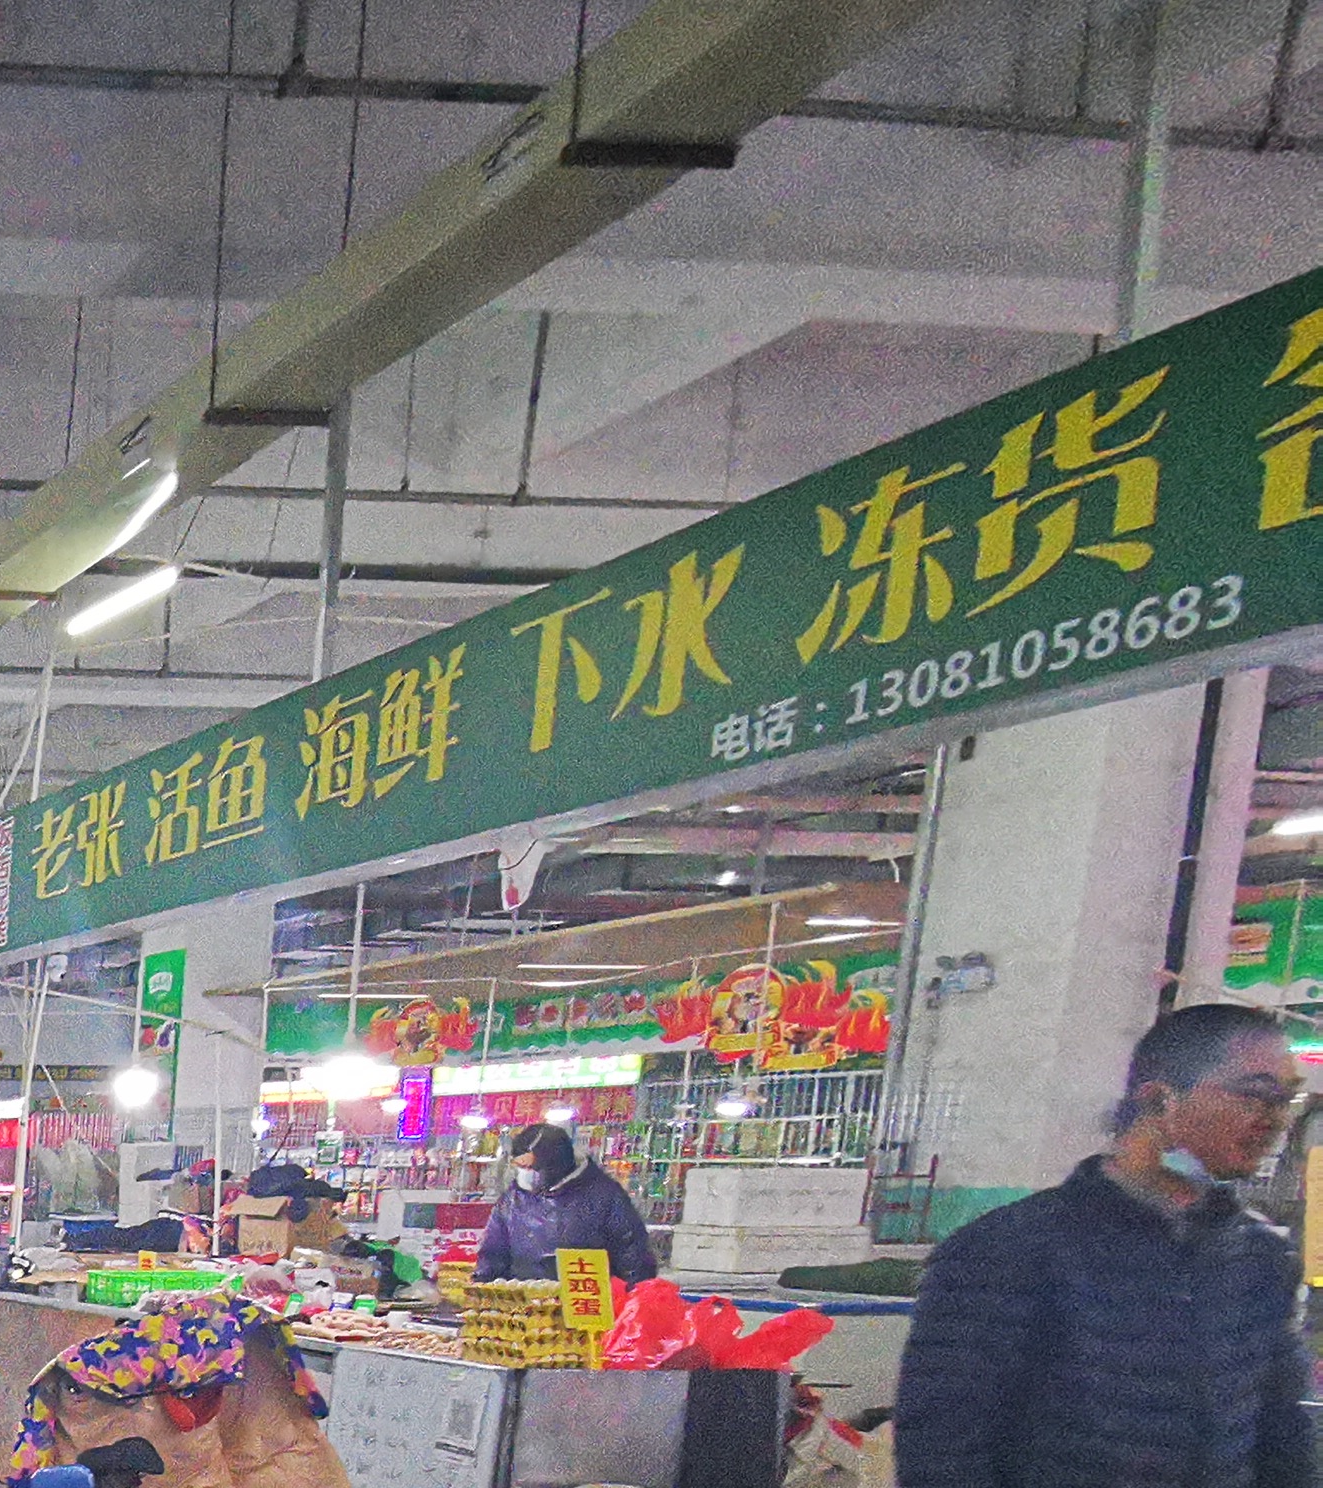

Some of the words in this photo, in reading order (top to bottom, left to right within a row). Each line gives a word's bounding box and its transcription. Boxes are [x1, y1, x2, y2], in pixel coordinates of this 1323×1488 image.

[30, 780, 127, 900] 老张
[144, 734, 267, 866] 活鱼
[295, 642, 468, 821] 海鲜
[510, 542, 746, 753] 下水
[794, 365, 1171, 666] 冻货
[566, 1257, 603, 1317] 土鸡蛋
